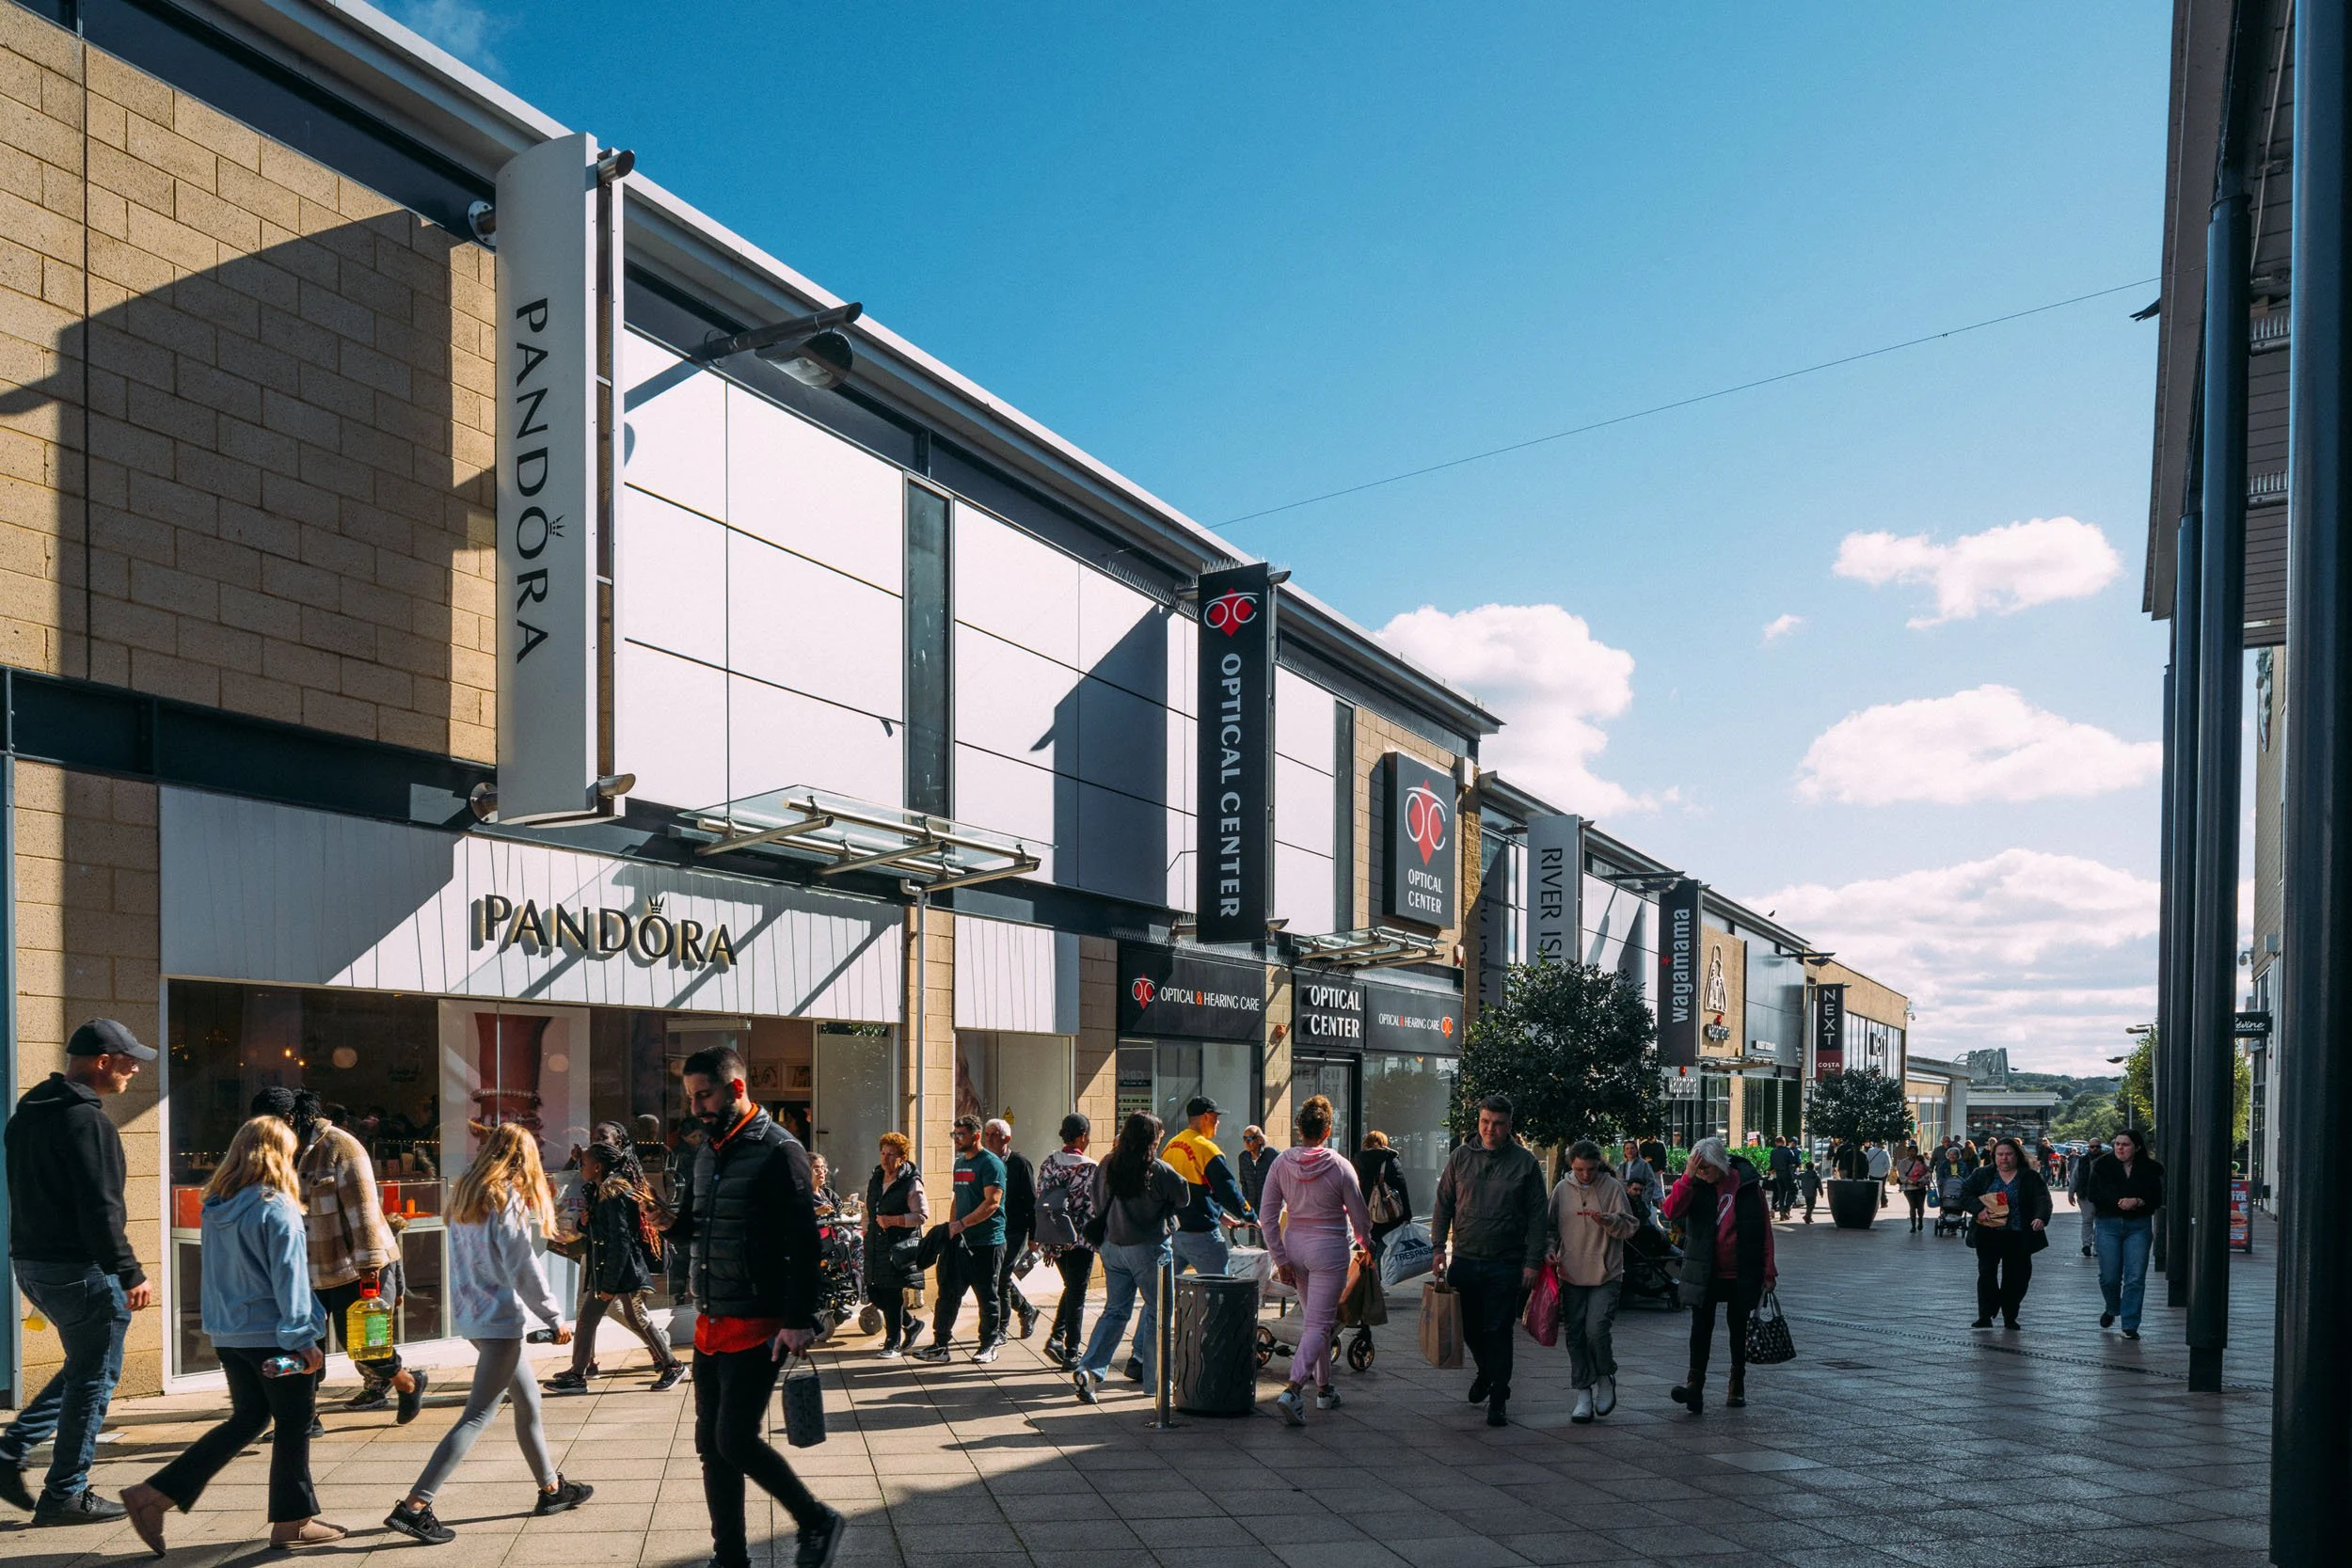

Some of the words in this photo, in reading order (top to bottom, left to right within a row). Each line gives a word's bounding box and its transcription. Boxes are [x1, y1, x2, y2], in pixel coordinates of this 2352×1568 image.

[516, 297, 548, 664] PANDORA
[1221, 653, 1241, 784] OPTICAL
[1220, 792, 1241, 917] CENTER
[1407, 868, 1443, 894] OPTICAL
[1540, 847, 1563, 920] RIVER
[1407, 891, 1442, 914] CENTER
[485, 894, 738, 966] PANDORA
[1540, 931, 1563, 958] ISL
[1673, 908, 1693, 1023] wagamama
[1160, 987, 1195, 1005] OPTICAL
[1196, 990, 1203, 1006] &
[1203, 991, 1239, 1009] HEARING
[1240, 997, 1260, 1011] CARE
[1310, 985, 1361, 1011] OPTICAL
[1824, 989, 1836, 1046] NEXT
[1311, 1014, 1359, 1038] CENTER
[1378, 1012, 1400, 1027] OPTICAL
[1405, 1016, 1427, 1029] HEARING
[1426, 1019, 1440, 1031] CARE
